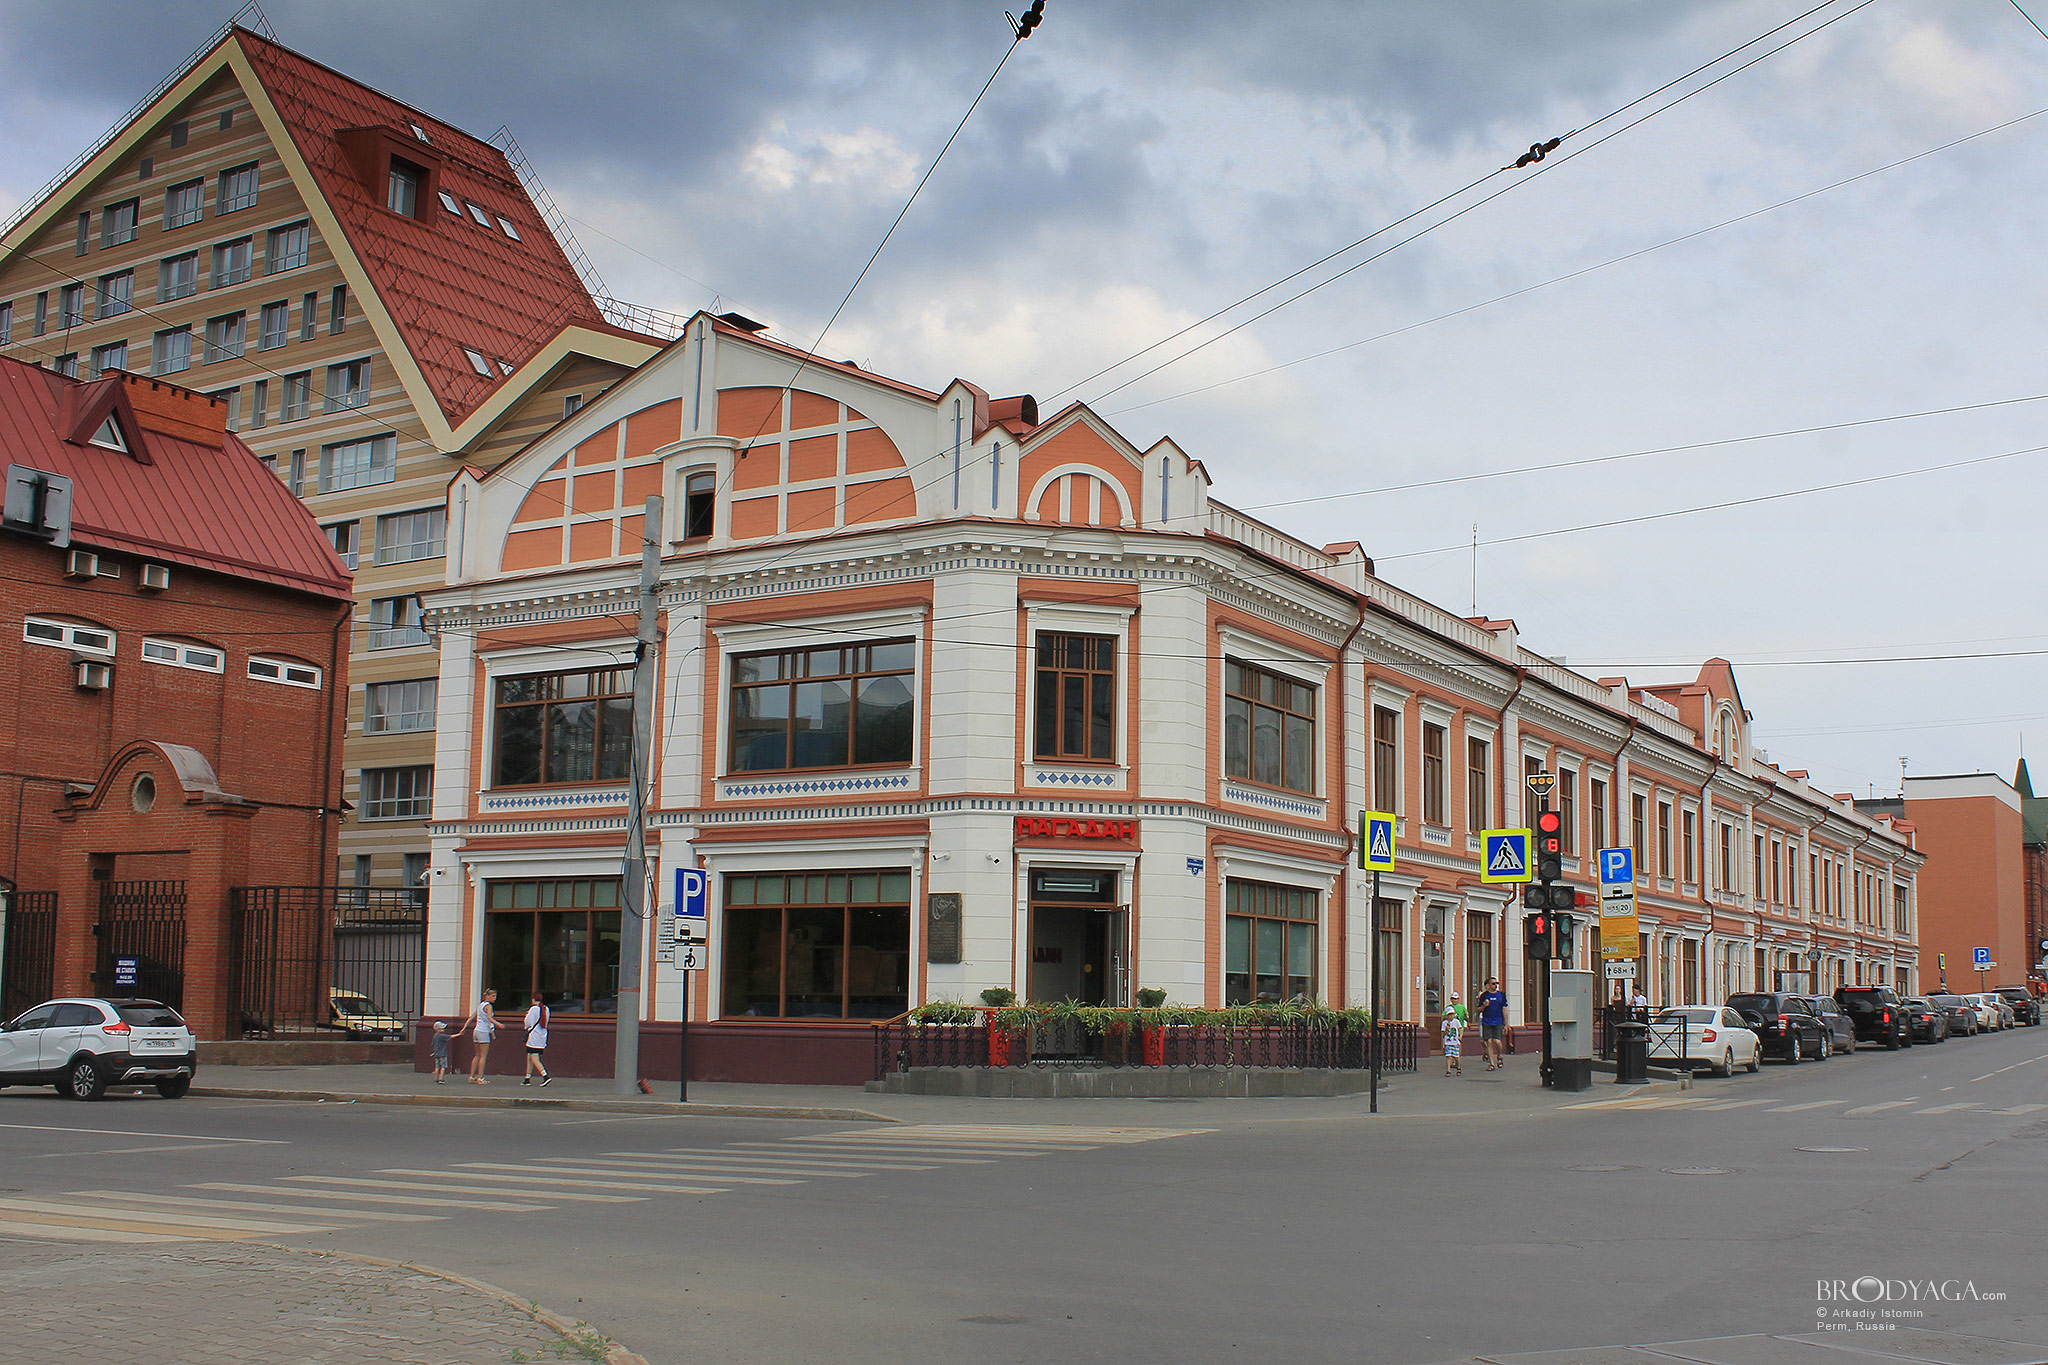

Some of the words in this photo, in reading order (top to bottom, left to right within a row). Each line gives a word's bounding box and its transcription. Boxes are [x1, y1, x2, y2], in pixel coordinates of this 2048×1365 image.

[1016, 818, 1135, 838] МАГАДАН
[1608, 852, 1626, 879] P
[682, 872, 703, 913] P
